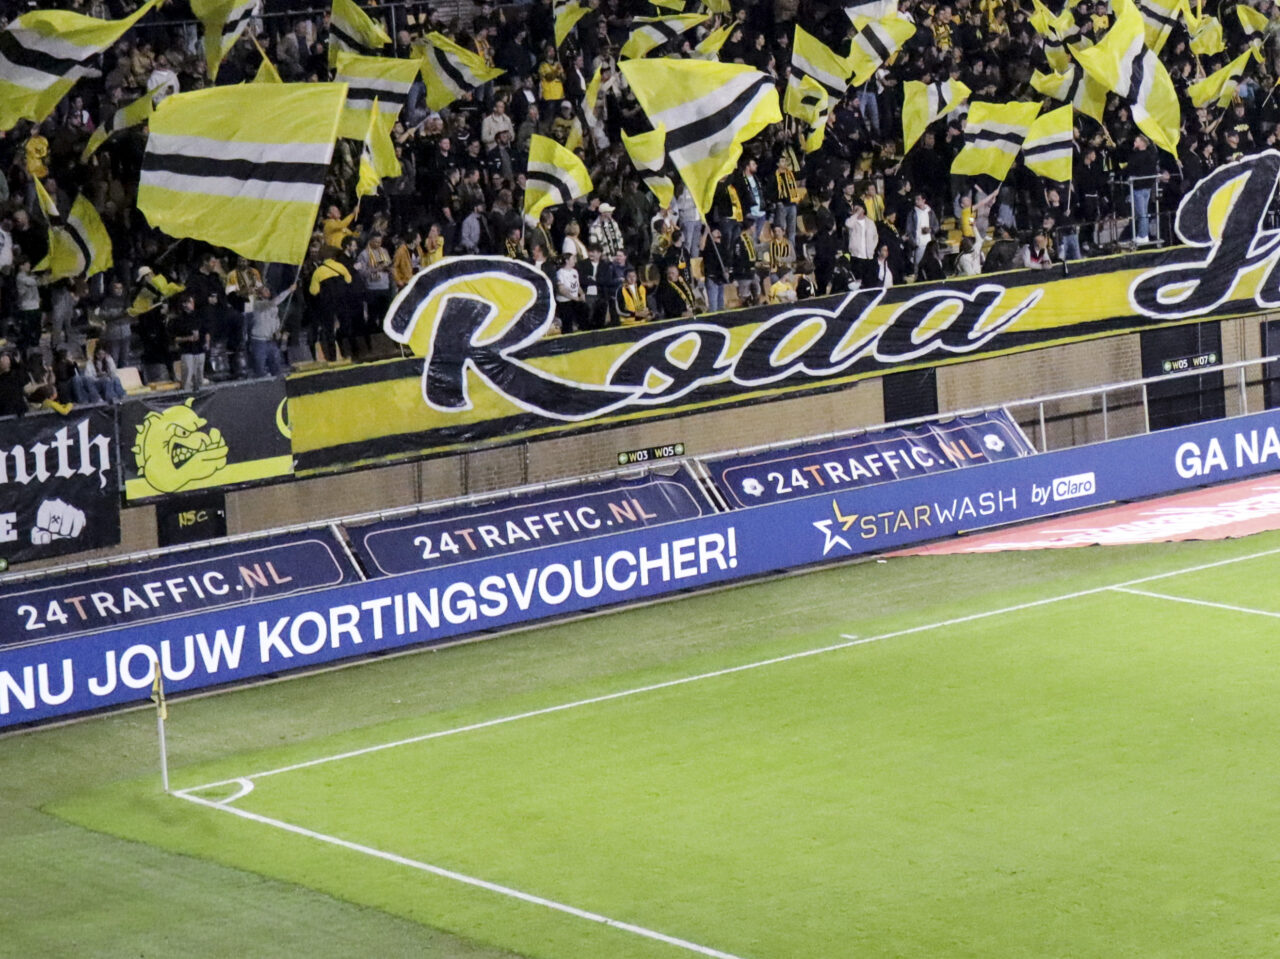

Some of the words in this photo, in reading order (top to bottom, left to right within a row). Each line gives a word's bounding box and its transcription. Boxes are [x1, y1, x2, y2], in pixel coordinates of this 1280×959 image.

[384, 255, 1044, 422] Roda
[1172, 359, 1188, 370] W05
[1193, 355, 1209, 366] W07
[629, 450, 649, 462] W03
[654, 446, 674, 458] W05
[767, 440, 984, 494] 24TRAFFIC.NL
[1175, 436, 1229, 480] GA
[413, 497, 657, 560] 24TRAFFIC.NL
[859, 487, 1018, 539] STARWASH
[1030, 482, 1051, 507] by
[1056, 477, 1092, 497] Claro
[0, 659, 74, 715] NU
[88, 625, 246, 697] JOUW
[258, 527, 739, 663] KORTINGSVOUCHER!
[17, 560, 292, 631] 24TRAFFIC.NL
